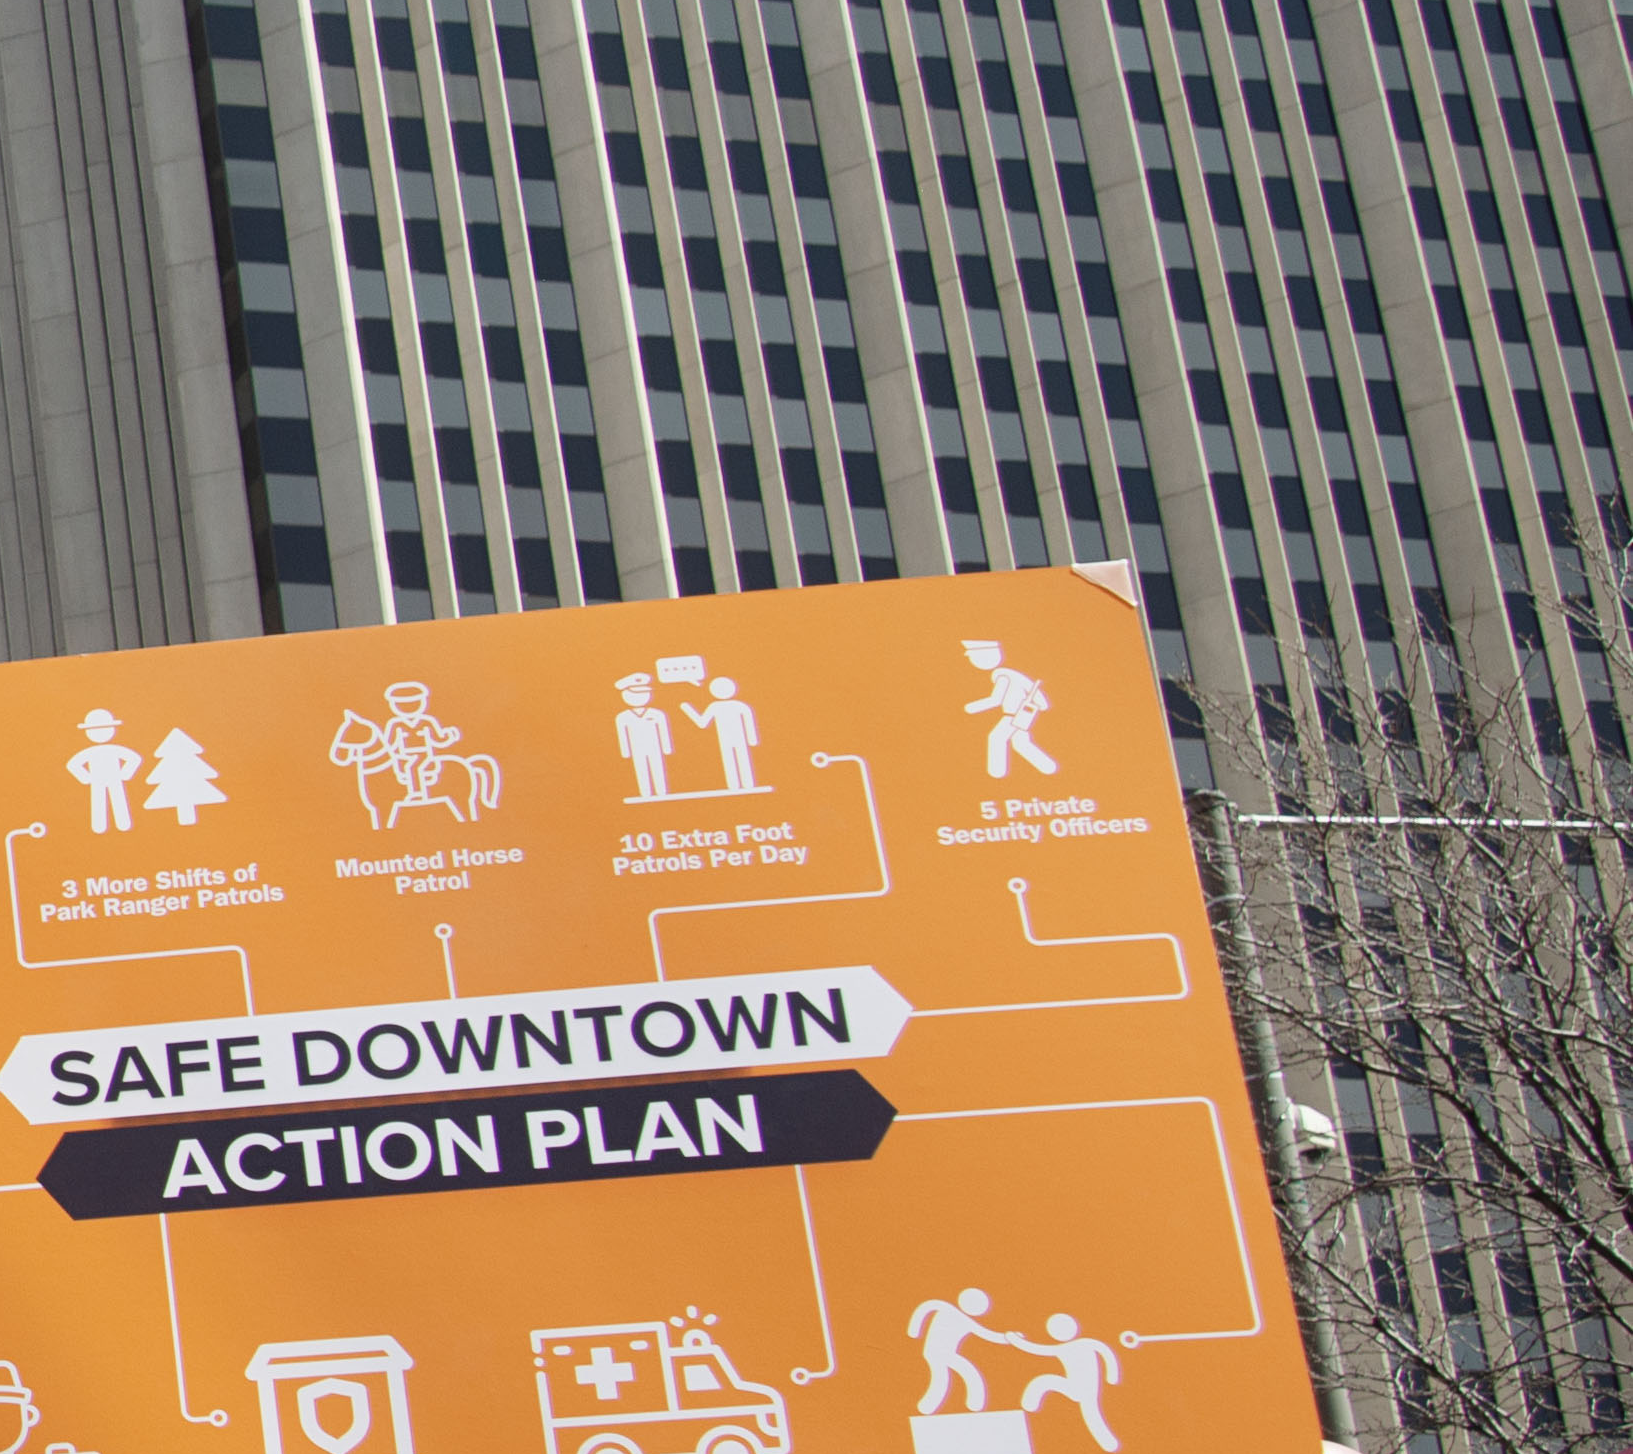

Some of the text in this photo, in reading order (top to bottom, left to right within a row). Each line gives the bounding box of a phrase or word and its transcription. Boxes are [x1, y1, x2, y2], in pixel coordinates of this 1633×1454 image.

[980, 795, 1098, 821] 5 Private
[620, 821, 795, 854] 10 Extra Foot
[937, 815, 1151, 846] Security Officers
[335, 847, 525, 879] Mounted Horse
[612, 844, 809, 876] Patrols Per Day
[62, 862, 258, 899] 3 More Shifts of
[395, 870, 471, 895] Patrol
[40, 883, 285, 923] Park Ranger Patrols
[50, 988, 850, 1107] SAFE DOWNTOWN
[162, 1094, 763, 1199] ACTION PLAN
